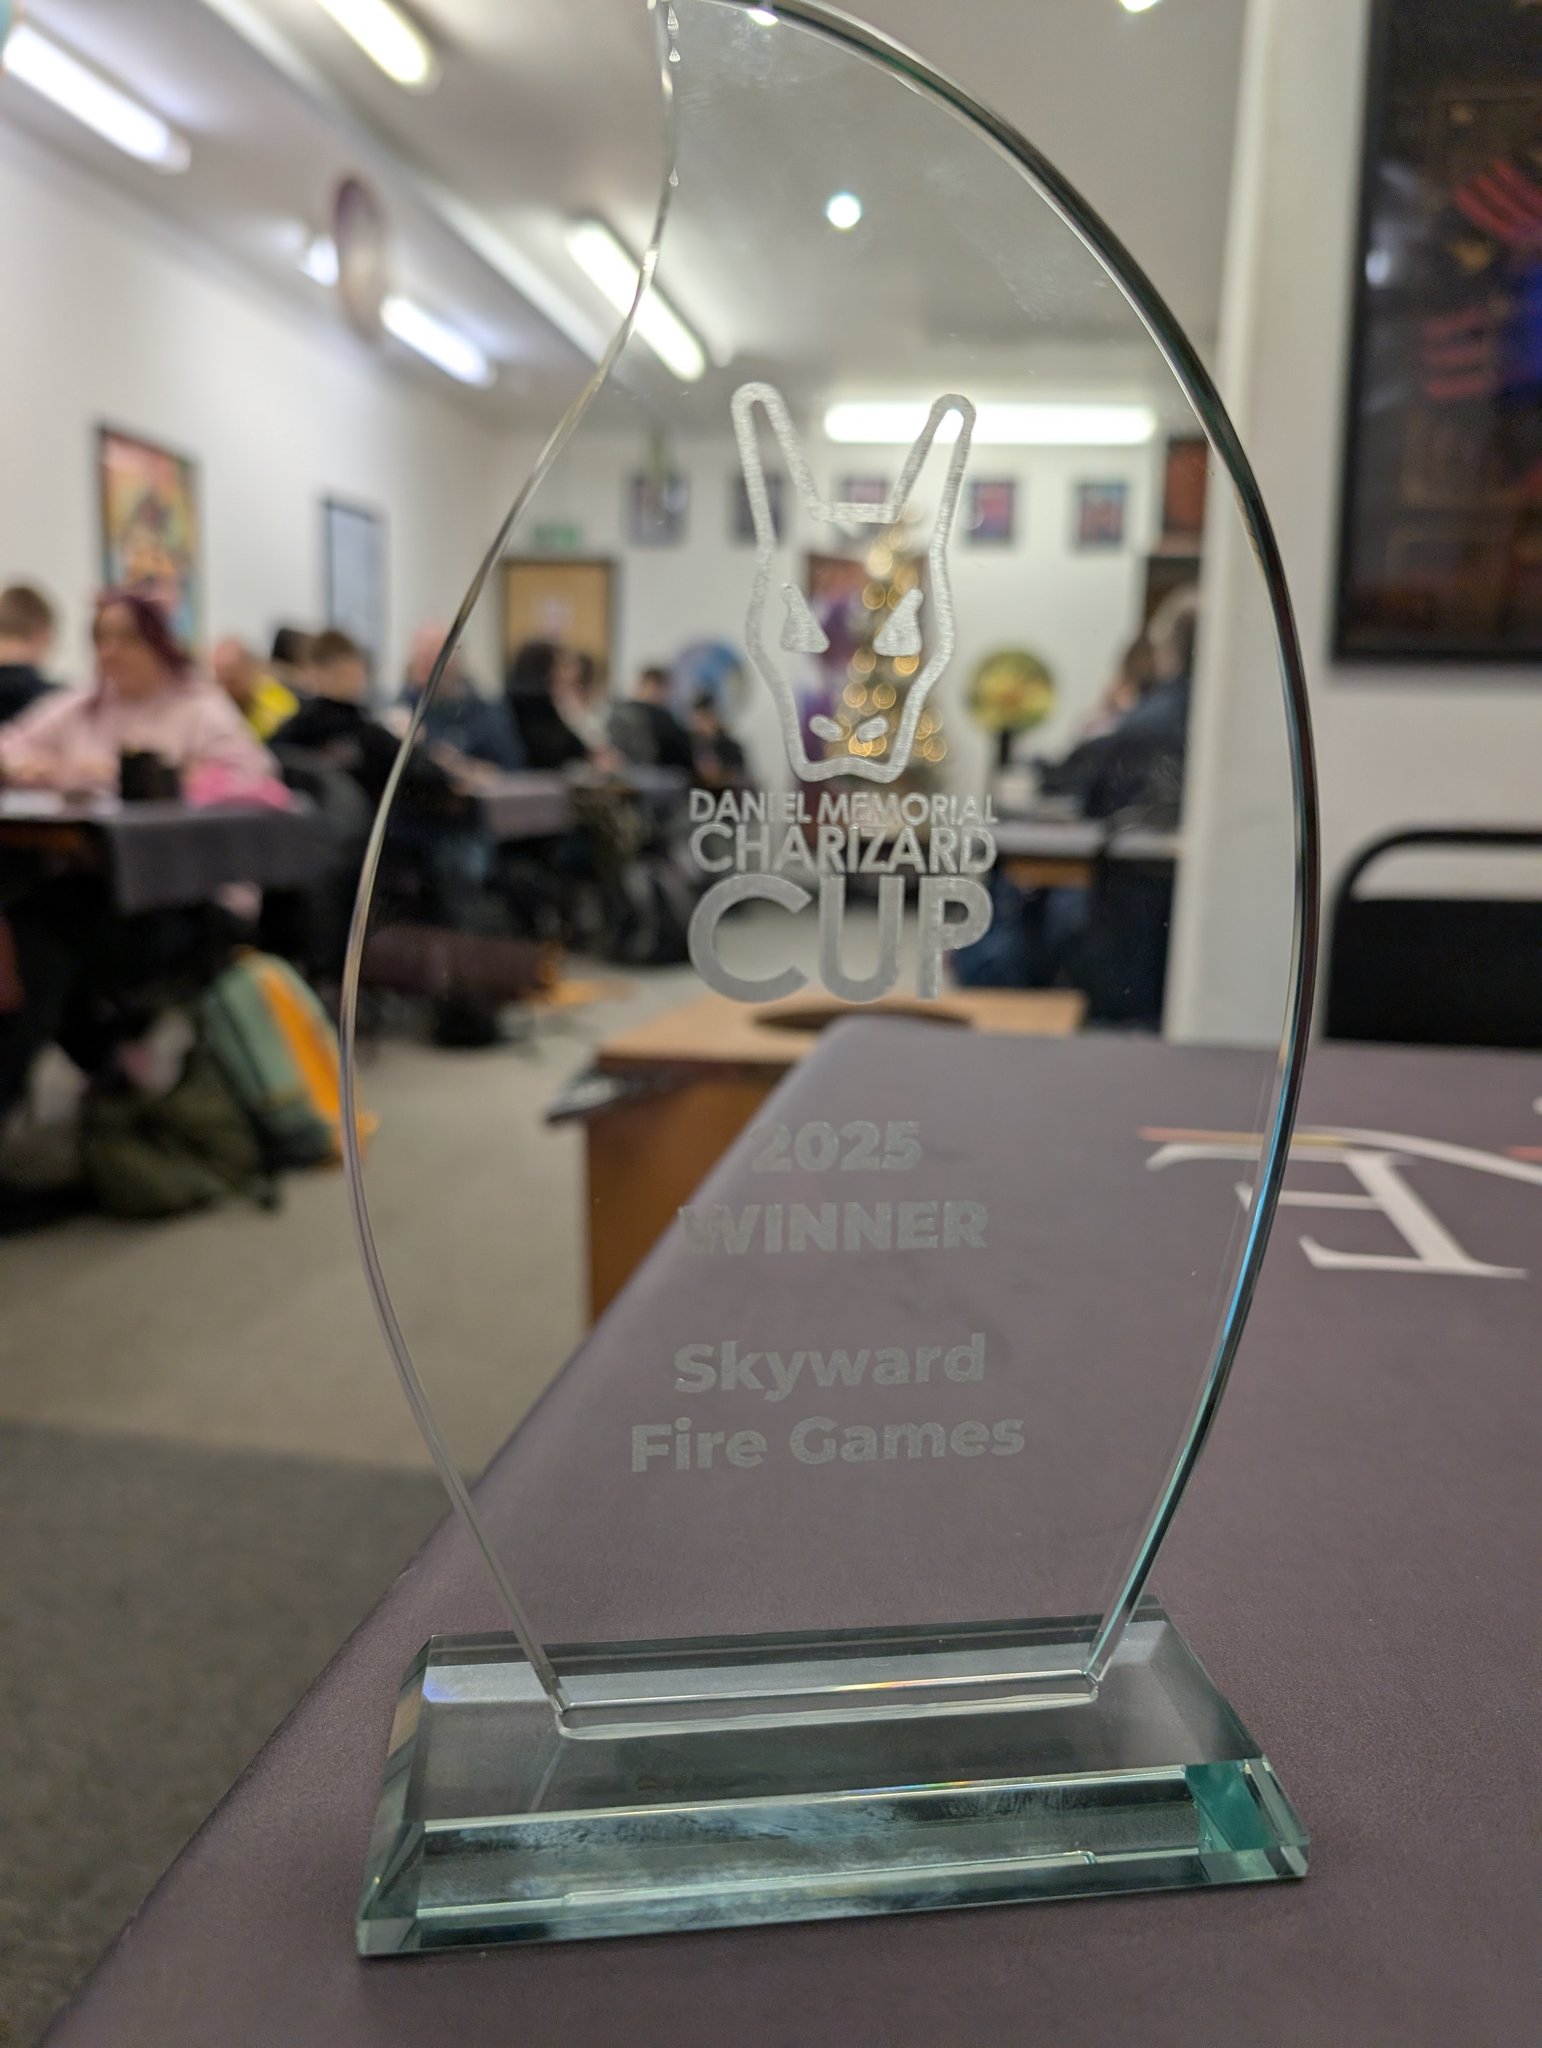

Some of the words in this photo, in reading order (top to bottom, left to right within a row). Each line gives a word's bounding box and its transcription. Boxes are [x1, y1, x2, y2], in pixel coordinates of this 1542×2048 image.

[689, 788, 812, 824] DANIEL
[817, 791, 998, 826] MEMORIAL
[689, 822, 998, 875] CHARIZARD
[687, 873, 993, 1005] CUP
[750, 1120, 923, 1173] 2025
[677, 1200, 989, 1255] WINNER
[674, 1333, 986, 1402] Skyward
[631, 1416, 768, 1472] Fire
[789, 1415, 1026, 1465] Games
